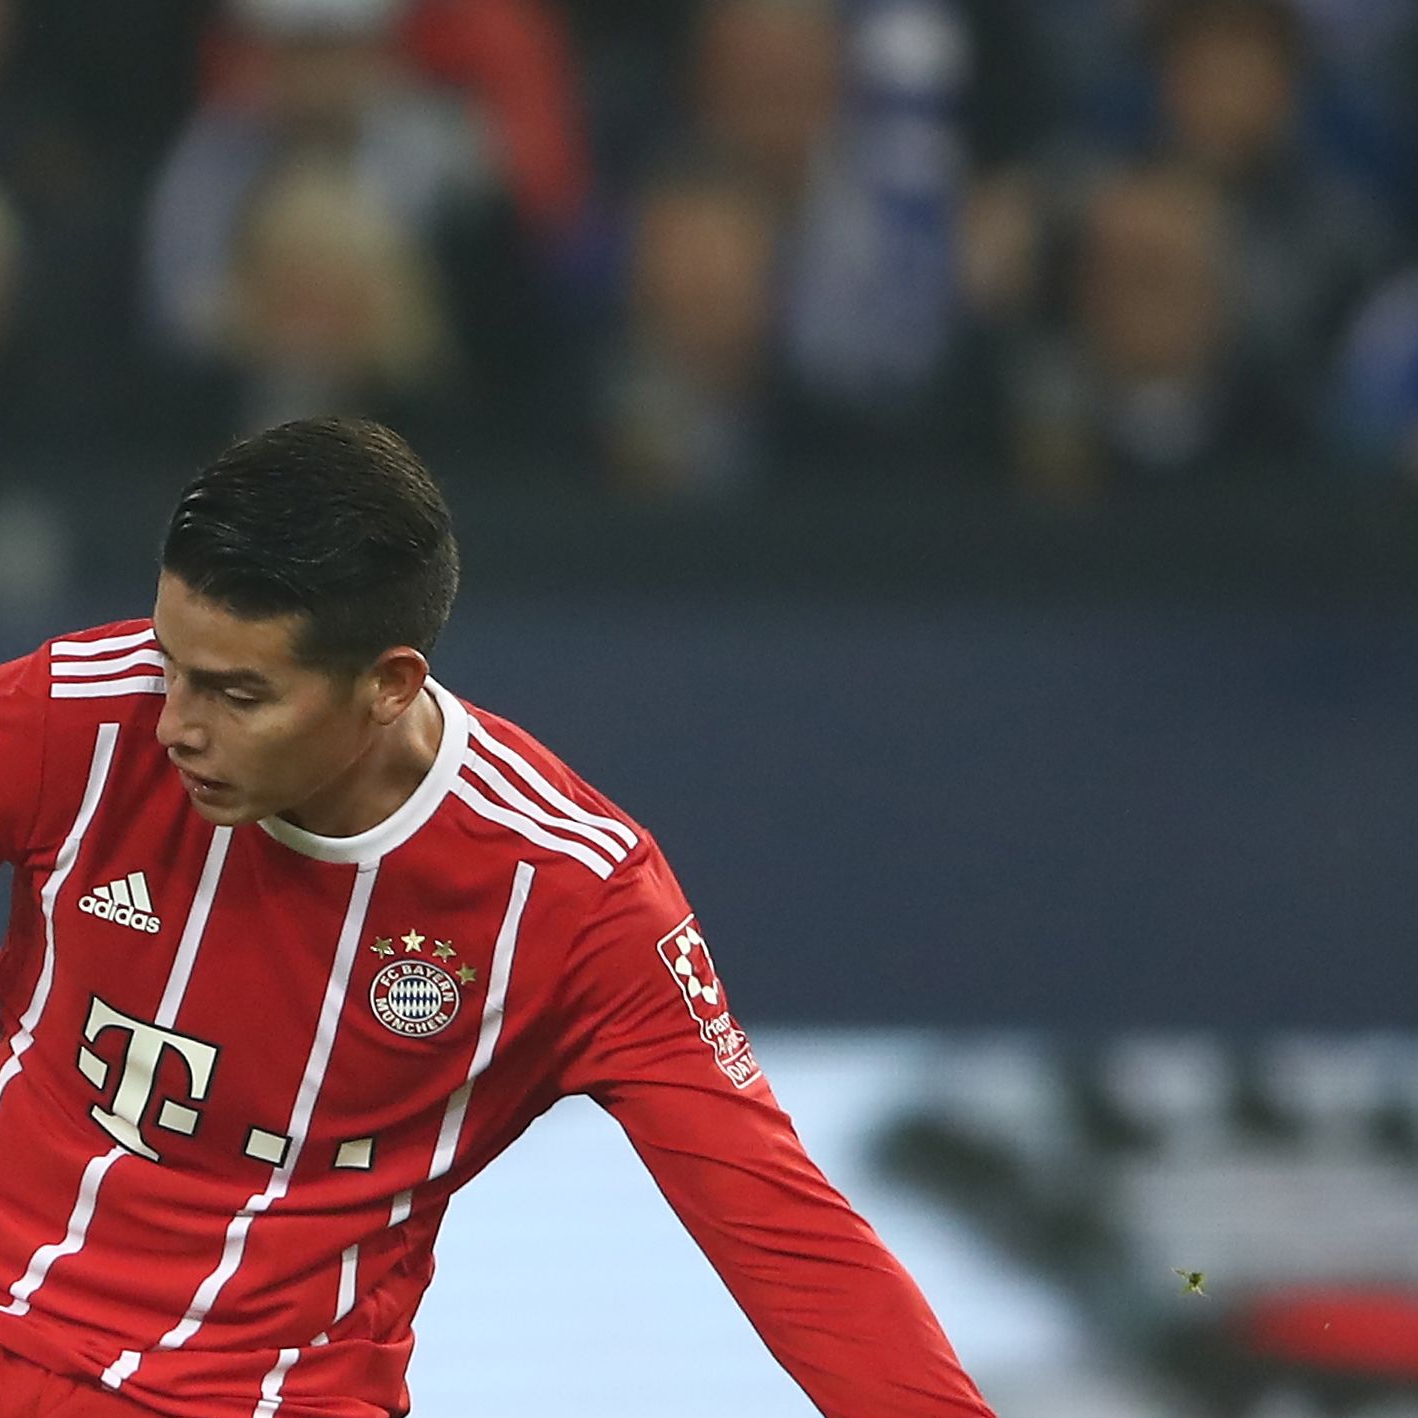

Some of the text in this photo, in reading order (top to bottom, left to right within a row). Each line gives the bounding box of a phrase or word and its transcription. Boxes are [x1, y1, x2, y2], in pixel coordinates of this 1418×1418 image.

[78, 895, 161, 934] adidas
[380, 964, 455, 1002] FC BAYERN
